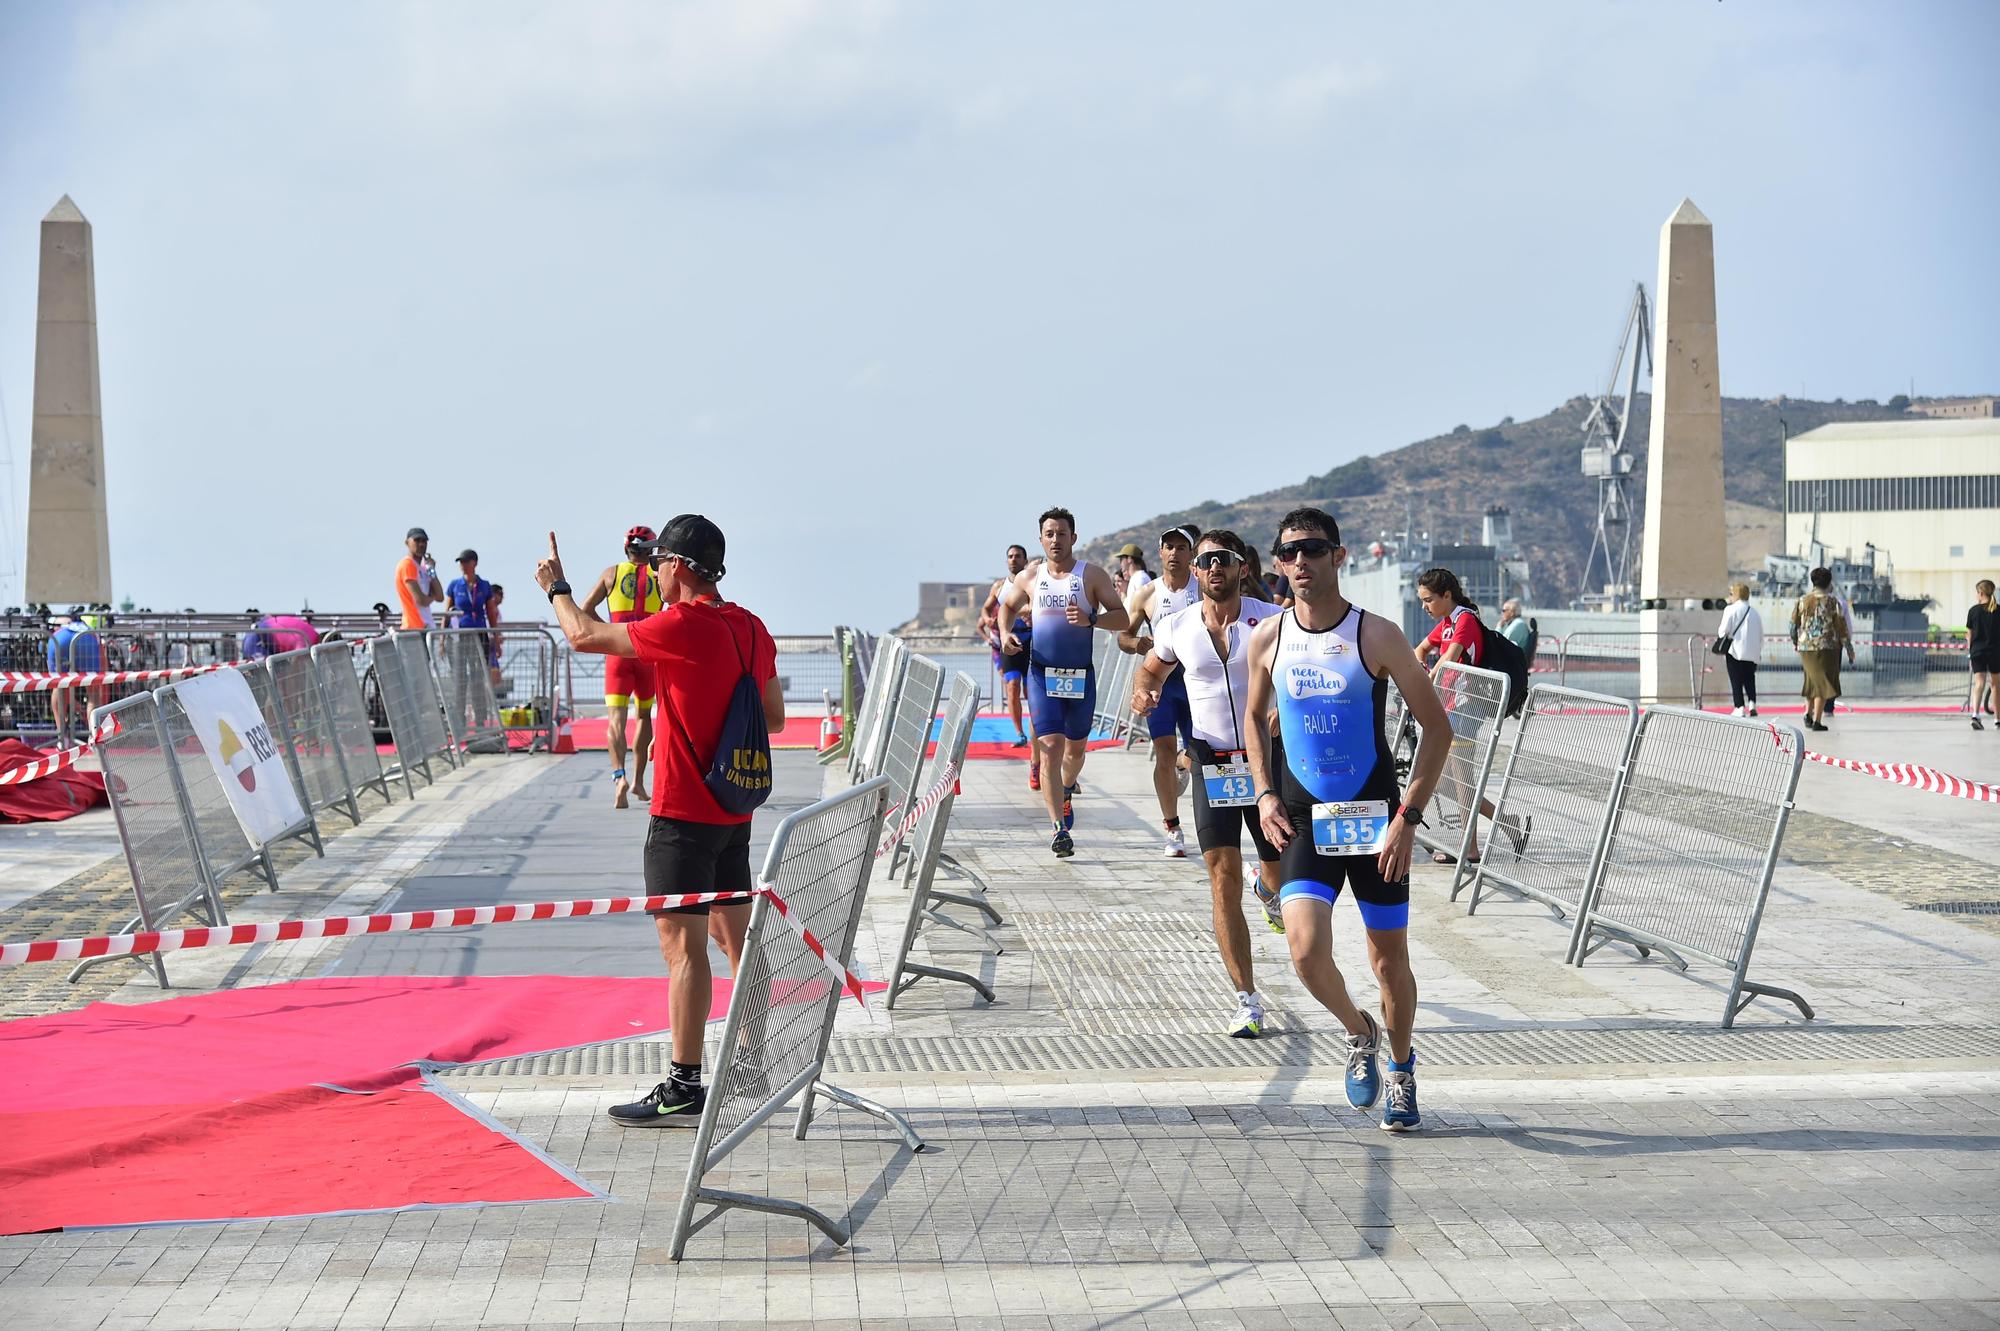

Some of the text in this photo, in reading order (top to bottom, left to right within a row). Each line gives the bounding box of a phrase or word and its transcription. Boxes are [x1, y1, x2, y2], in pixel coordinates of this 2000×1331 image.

[1039, 593, 1077, 608] MORENO
[1292, 667, 1318, 677] new
[1056, 678, 1073, 691] 26
[1296, 674, 1341, 696] garden
[1303, 710, 1331, 735] RAÚL
[1223, 777, 1249, 797] 43
[1326, 819, 1375, 844] 135
